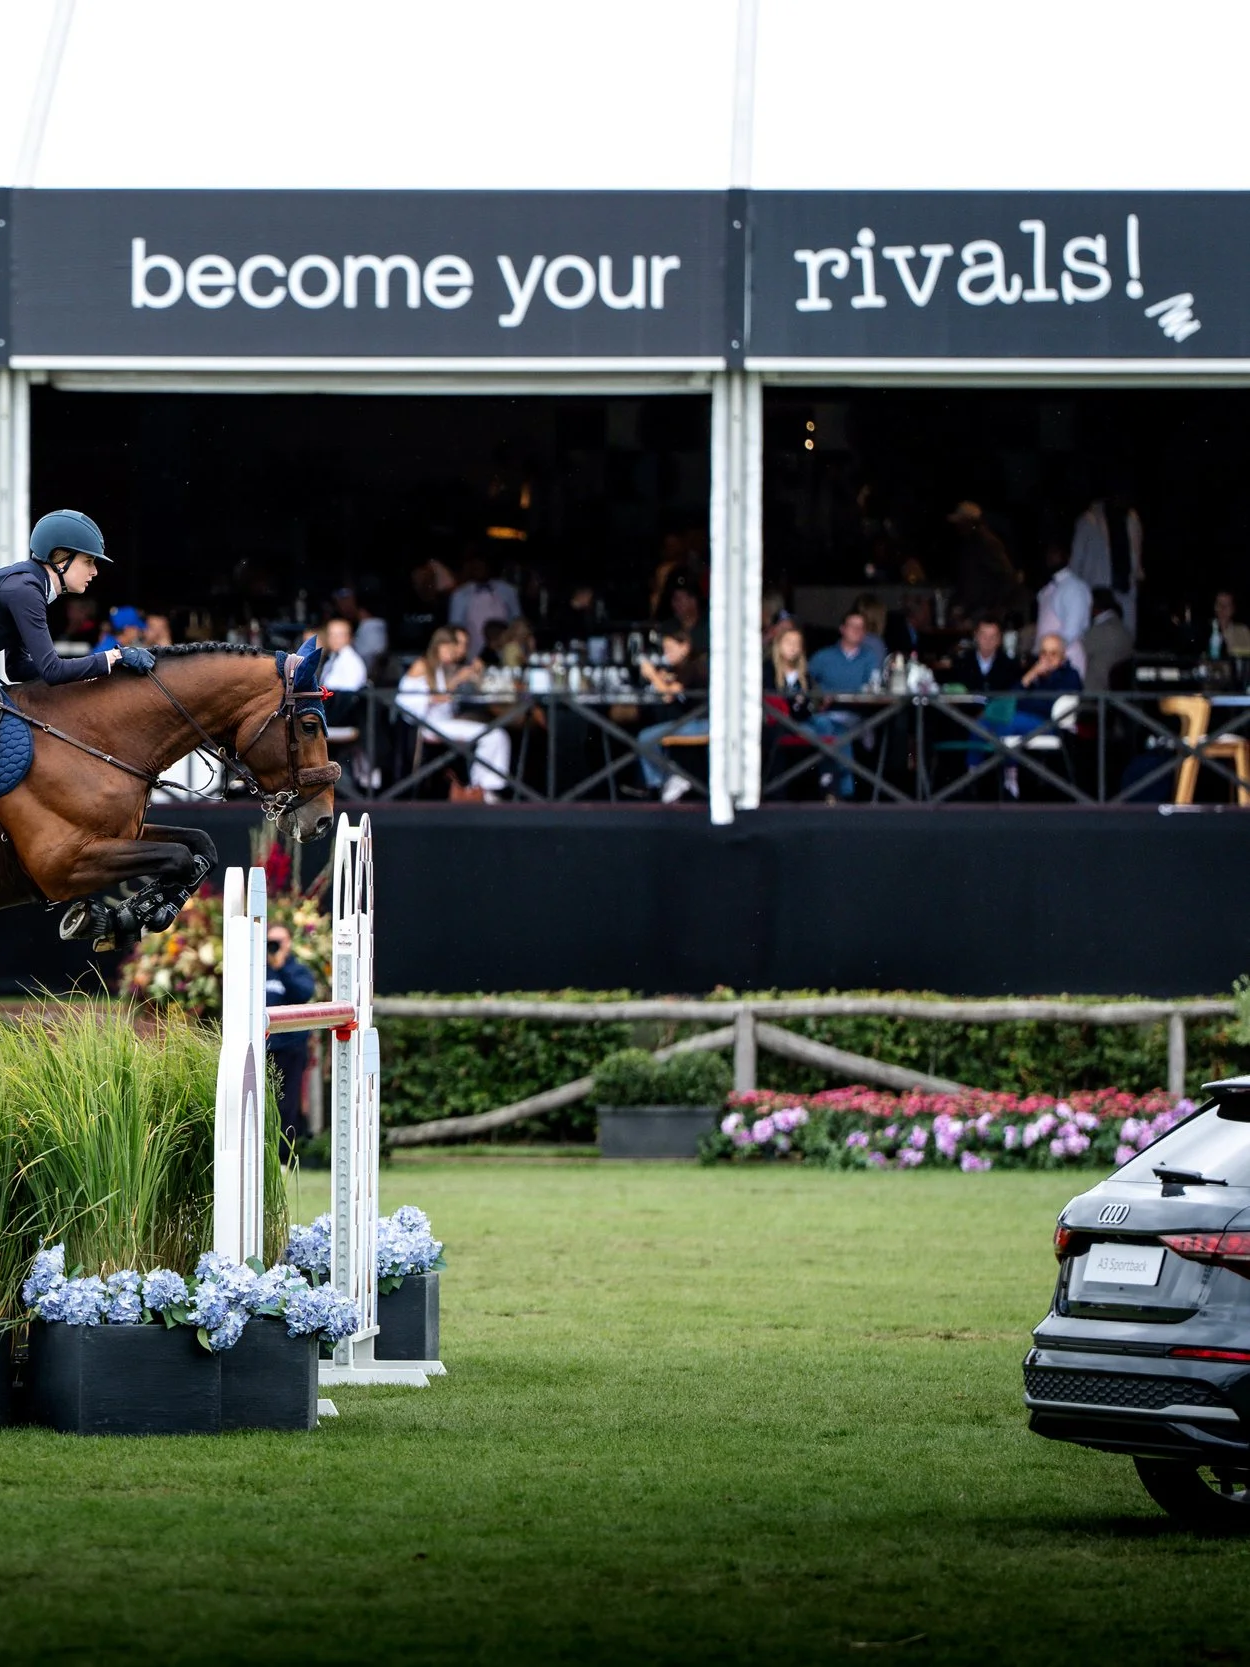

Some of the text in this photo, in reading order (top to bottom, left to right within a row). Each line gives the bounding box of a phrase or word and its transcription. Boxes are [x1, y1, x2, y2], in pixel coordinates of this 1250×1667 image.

[132, 238, 474, 309] become
[498, 255, 681, 328] your
[794, 214, 1144, 312] rivals!
[1097, 1257, 1147, 1273] A3 Sportback
